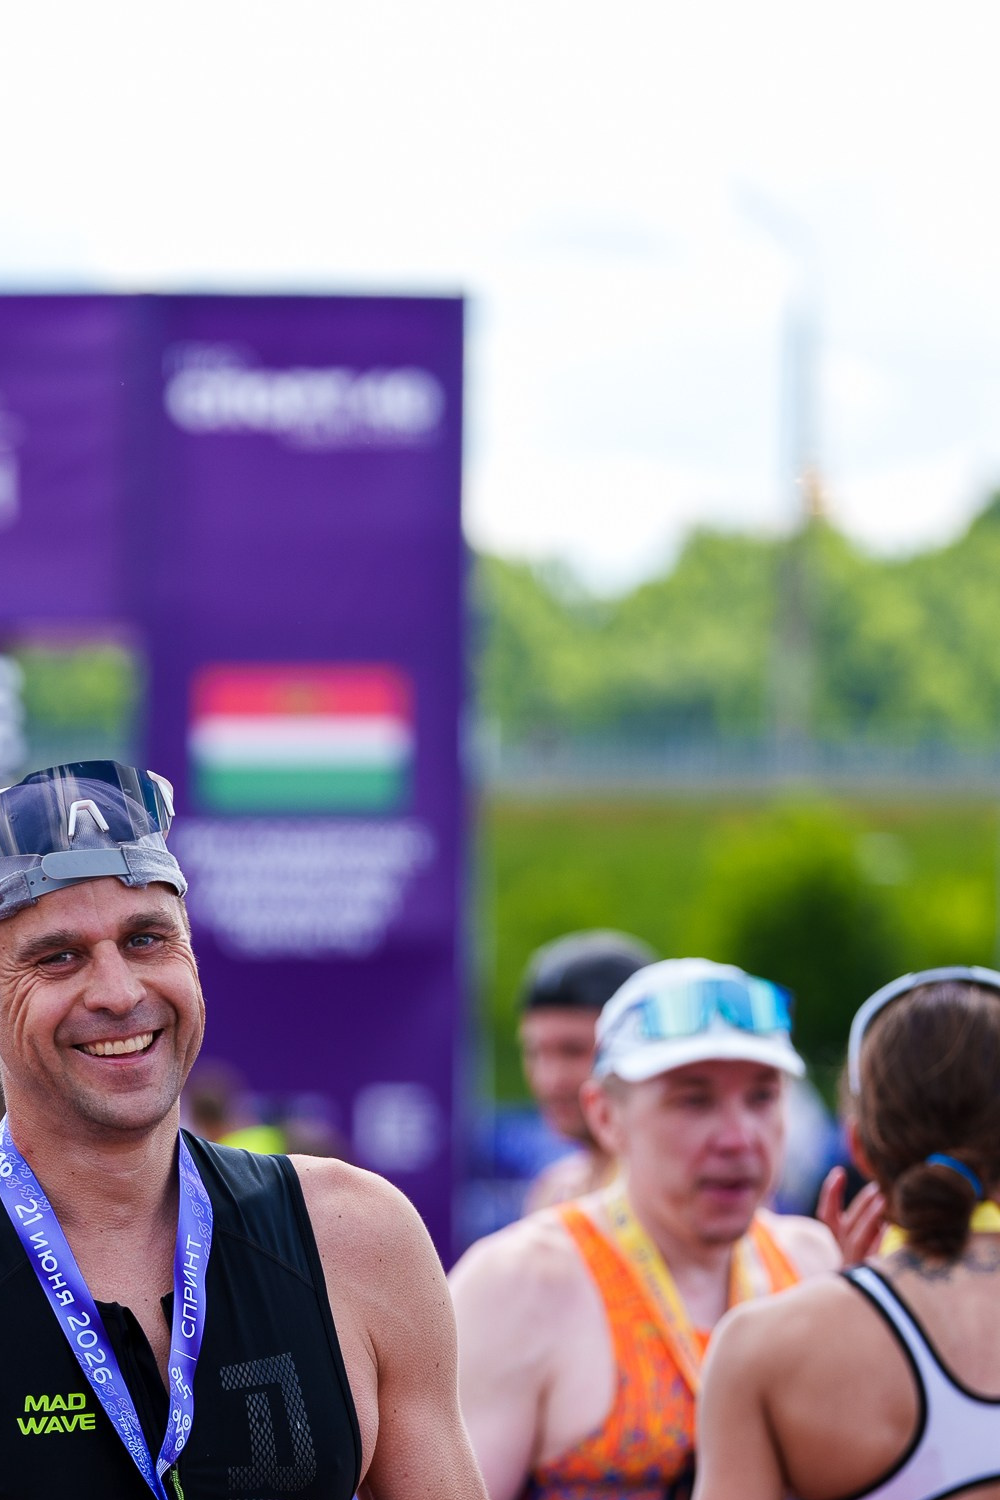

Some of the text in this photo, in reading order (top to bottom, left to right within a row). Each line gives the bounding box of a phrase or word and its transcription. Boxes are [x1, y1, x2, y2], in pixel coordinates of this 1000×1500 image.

[14, 1198, 113, 1384] 21 ИЮНЯ 2026
[181, 1234, 202, 1338] СПРИНТ
[17, 1413, 96, 1435] WAVE
[24, 1393, 86, 1412] MAD
